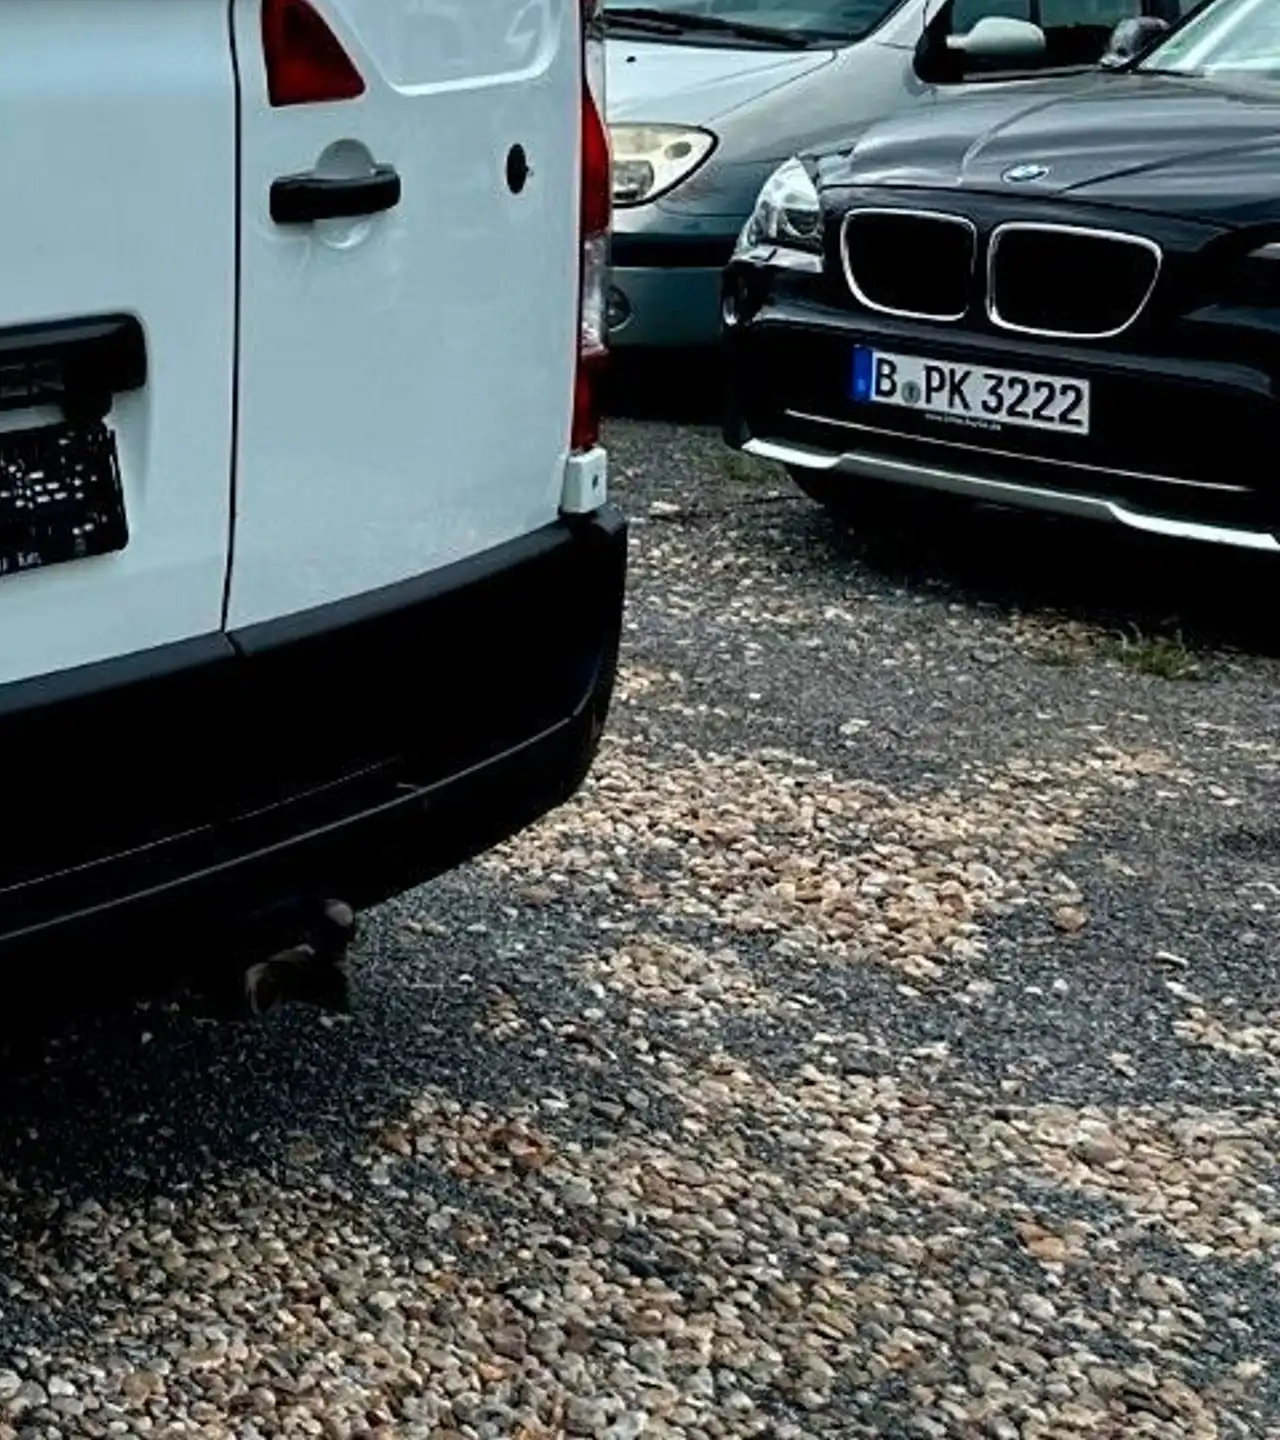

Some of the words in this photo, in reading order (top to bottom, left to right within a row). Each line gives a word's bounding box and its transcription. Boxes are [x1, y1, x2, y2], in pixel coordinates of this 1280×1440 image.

[874, 357, 898, 398] B
[923, 364, 973, 412] PK
[980, 373, 1084, 426] 3222
